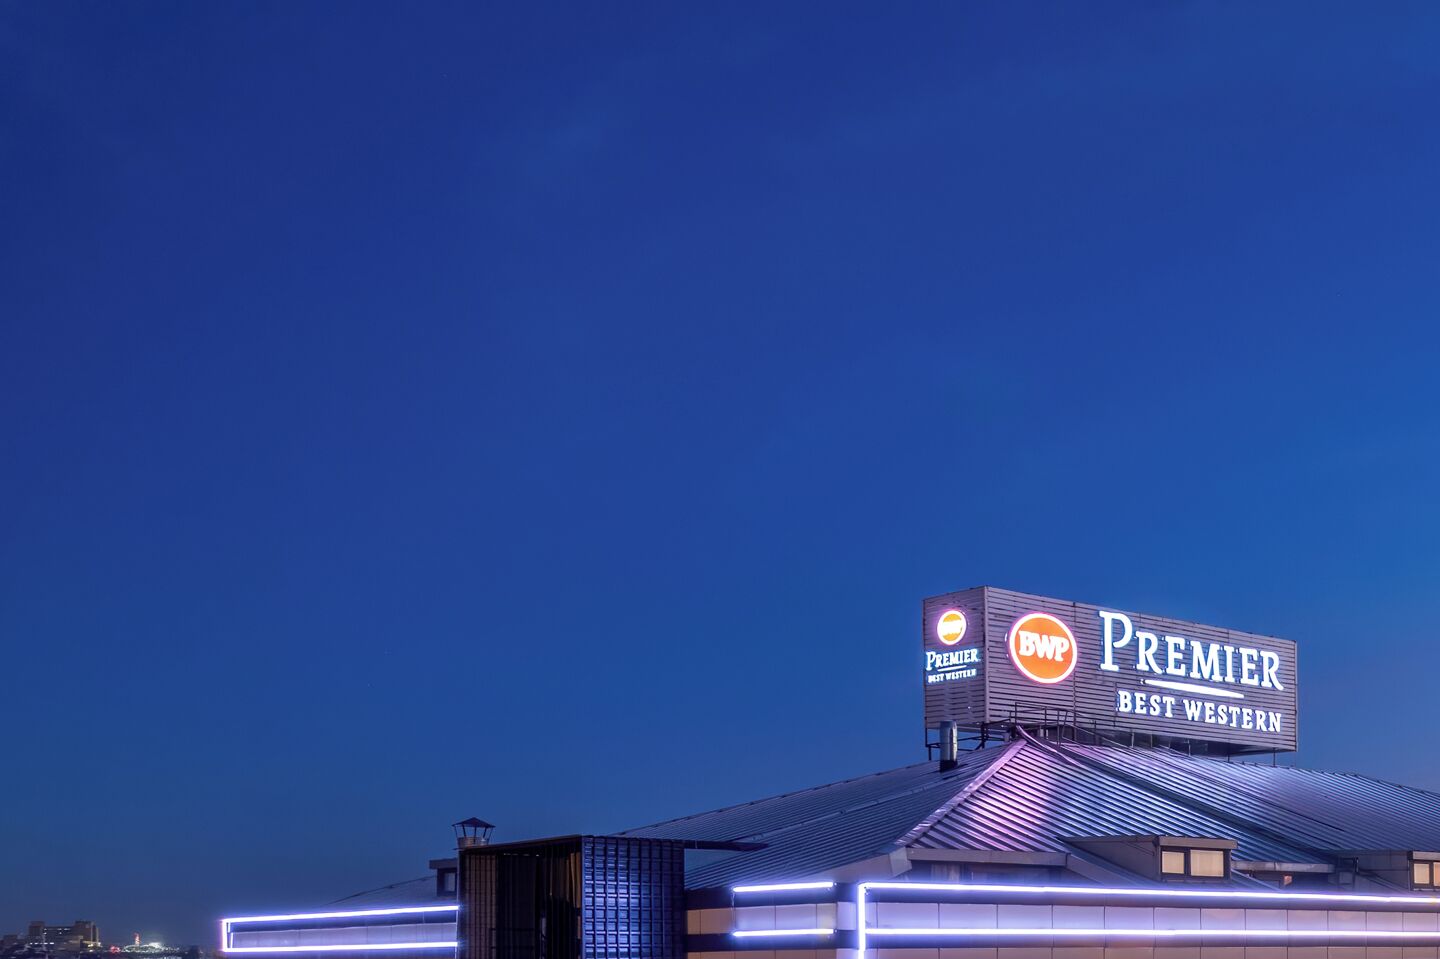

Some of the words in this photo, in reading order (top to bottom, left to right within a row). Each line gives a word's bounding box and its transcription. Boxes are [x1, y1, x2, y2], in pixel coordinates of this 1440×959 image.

[925, 648, 979, 671] PREMIER
[1018, 630, 1071, 662] BWP
[1099, 610, 1284, 691] PREMIER
[928, 673, 945, 684] BEST
[945, 668, 977, 680] WESTERN
[1117, 690, 1176, 718] BEST
[1183, 699, 1282, 733] WESTERN
